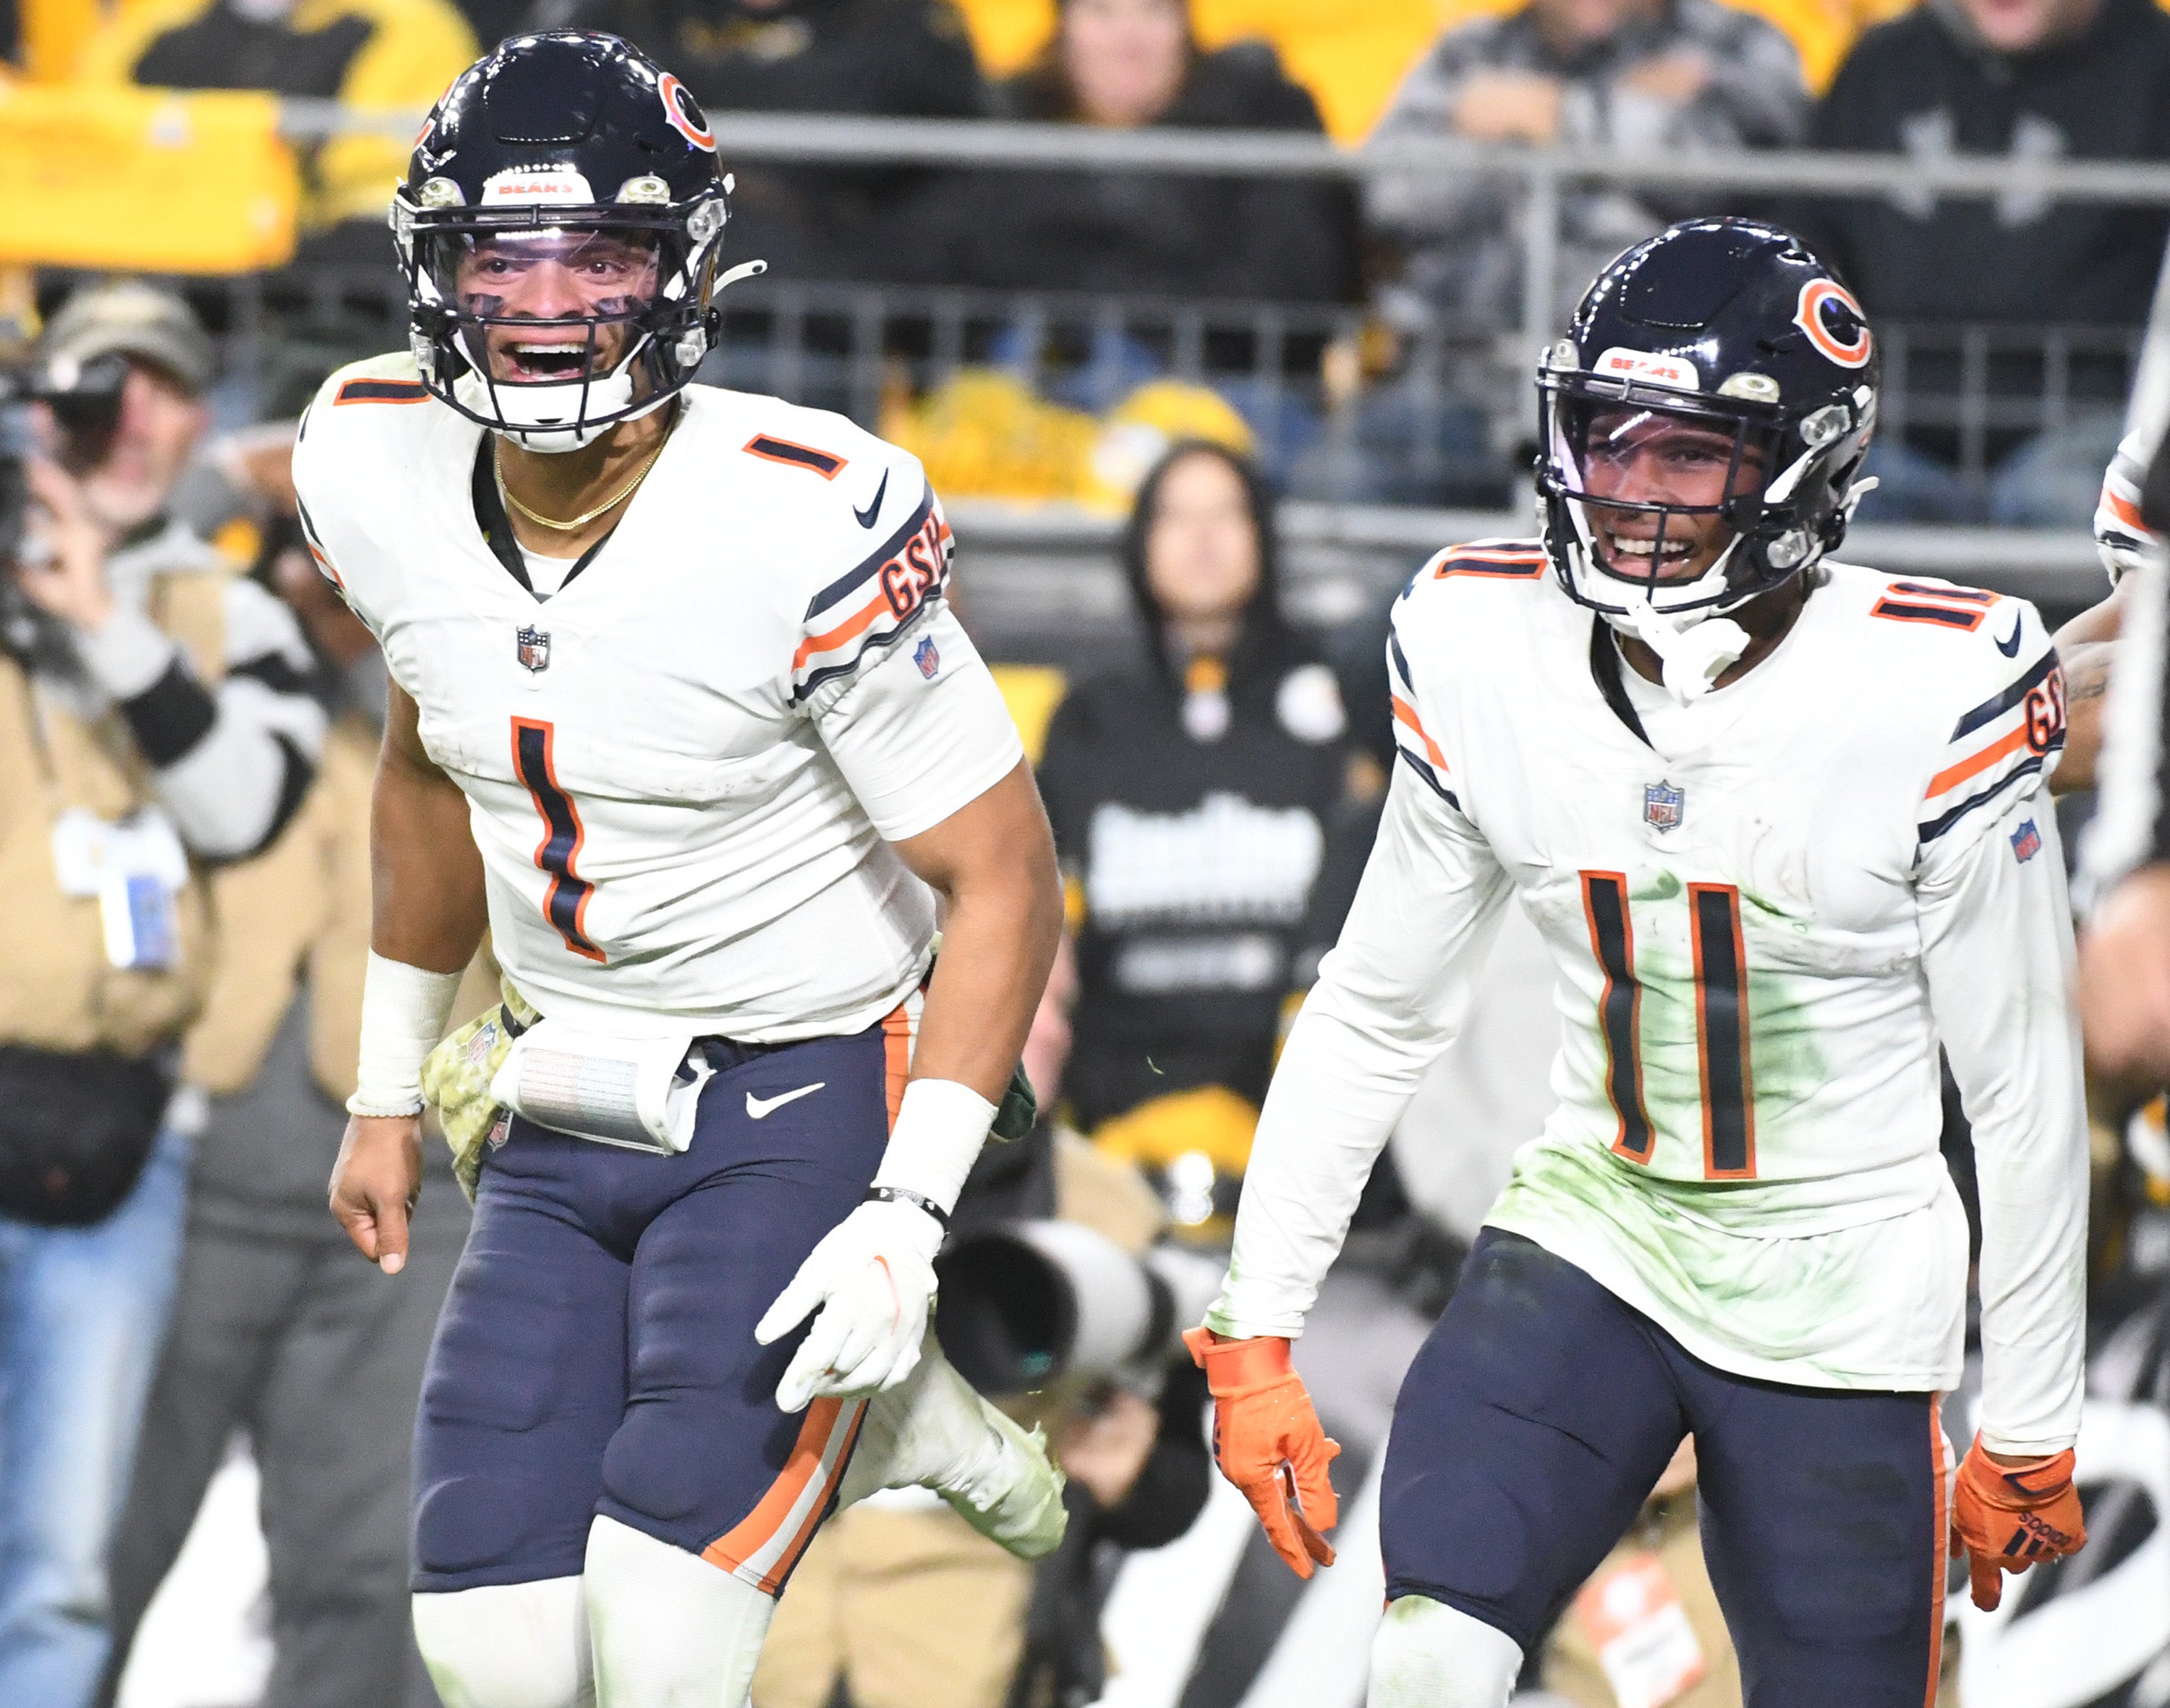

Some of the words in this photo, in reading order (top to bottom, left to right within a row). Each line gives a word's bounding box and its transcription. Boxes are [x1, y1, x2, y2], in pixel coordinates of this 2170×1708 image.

[1792, 278, 1872, 369] C
[333, 378, 433, 407] 1
[741, 433, 849, 482] 1
[1869, 581, 2002, 633] 11
[2024, 668, 2067, 757] GS
[511, 715, 607, 964] 1
[1578, 870, 1758, 1180] 11
